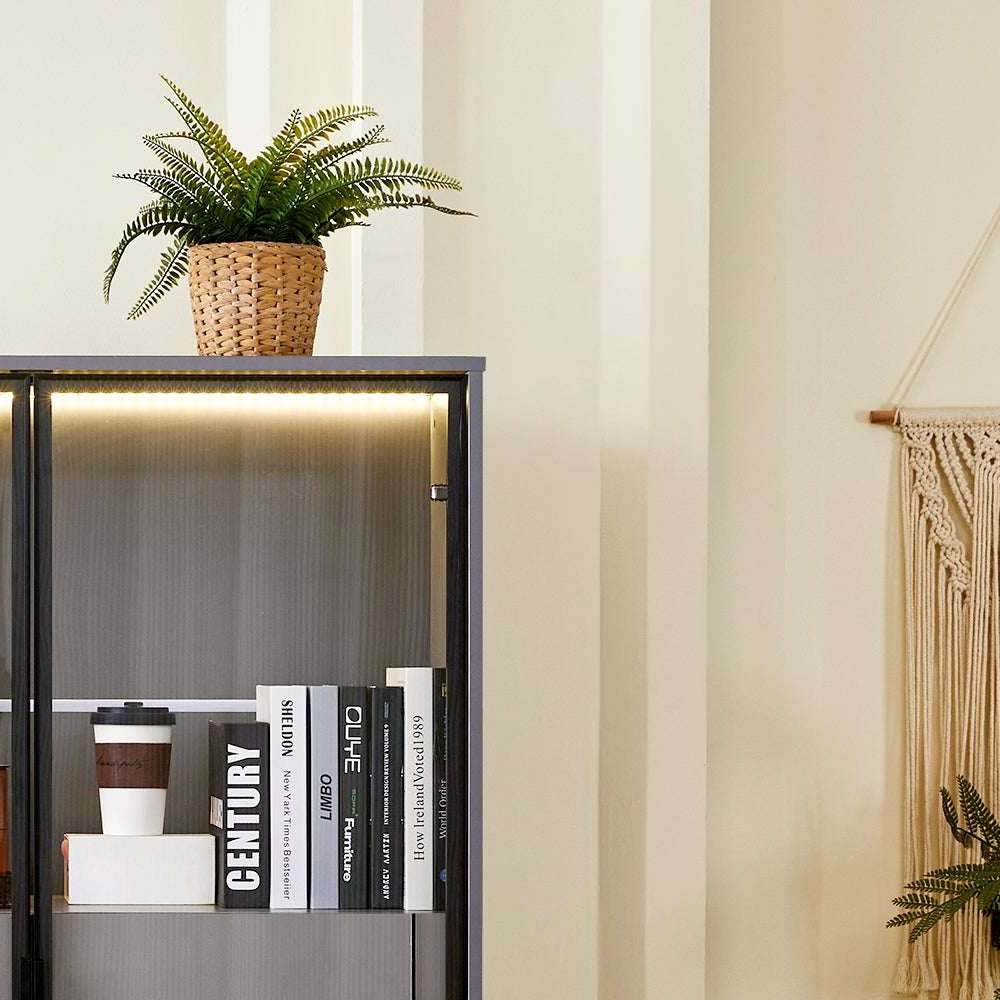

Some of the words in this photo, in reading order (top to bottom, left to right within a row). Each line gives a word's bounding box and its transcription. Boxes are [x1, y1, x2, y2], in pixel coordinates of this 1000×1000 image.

[281, 699, 294, 757] SHELDON
[382, 729, 390, 753] VOLUME
[382, 753, 390, 776] REVIEW
[283, 770, 292, 792] New
[382, 776, 390, 797] DESIGN
[438, 778, 447, 808] Order
[319, 773, 333, 821] LIMBO
[382, 797, 390, 825] INTERIOR
[226, 743, 261, 891] CENTURY
[438, 811, 447, 840] World
[283, 818, 292, 848] Times
[412, 831, 425, 861] How
[343, 817, 355, 882] Furniture
